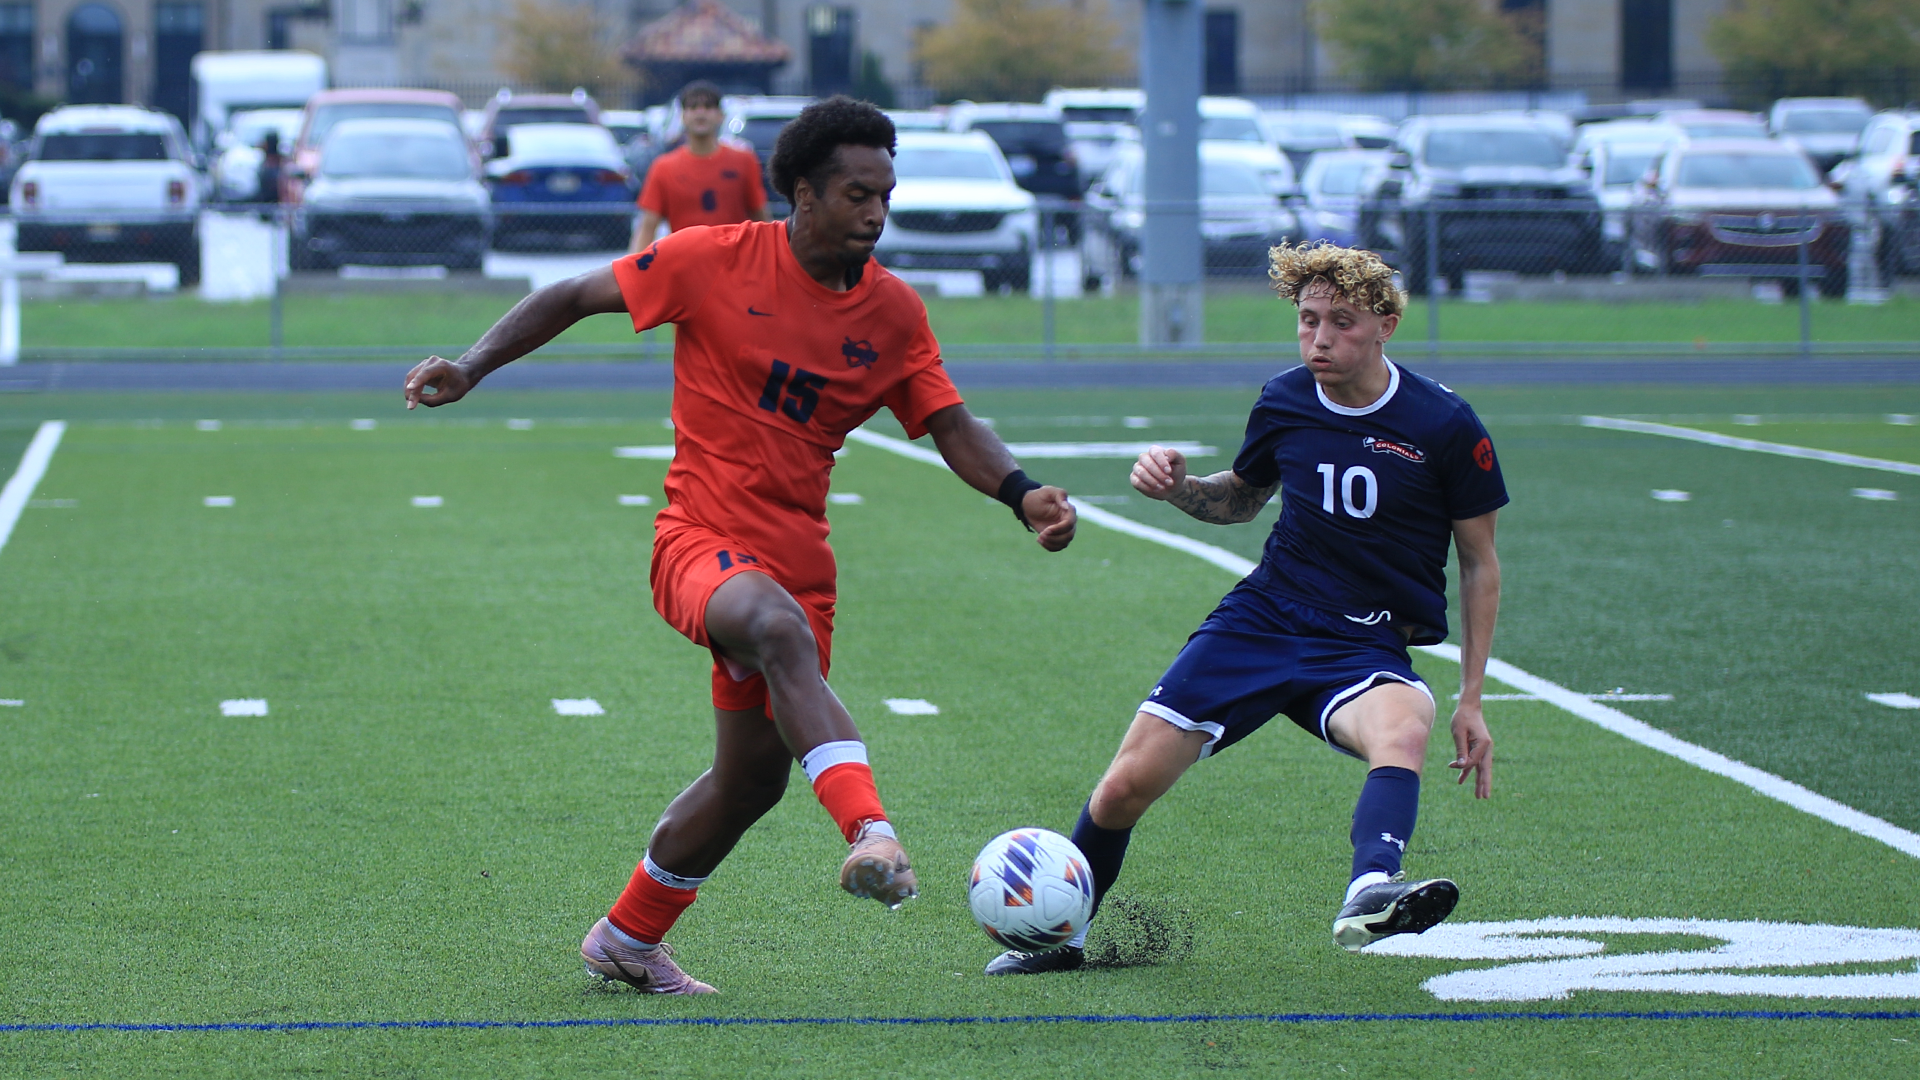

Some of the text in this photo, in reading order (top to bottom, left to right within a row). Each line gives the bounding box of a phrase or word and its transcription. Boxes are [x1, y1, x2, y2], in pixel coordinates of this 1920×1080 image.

[758, 358, 829, 424] 15
[1376, 442, 1420, 460] COLONIALS
[1317, 463, 1378, 519] 10
